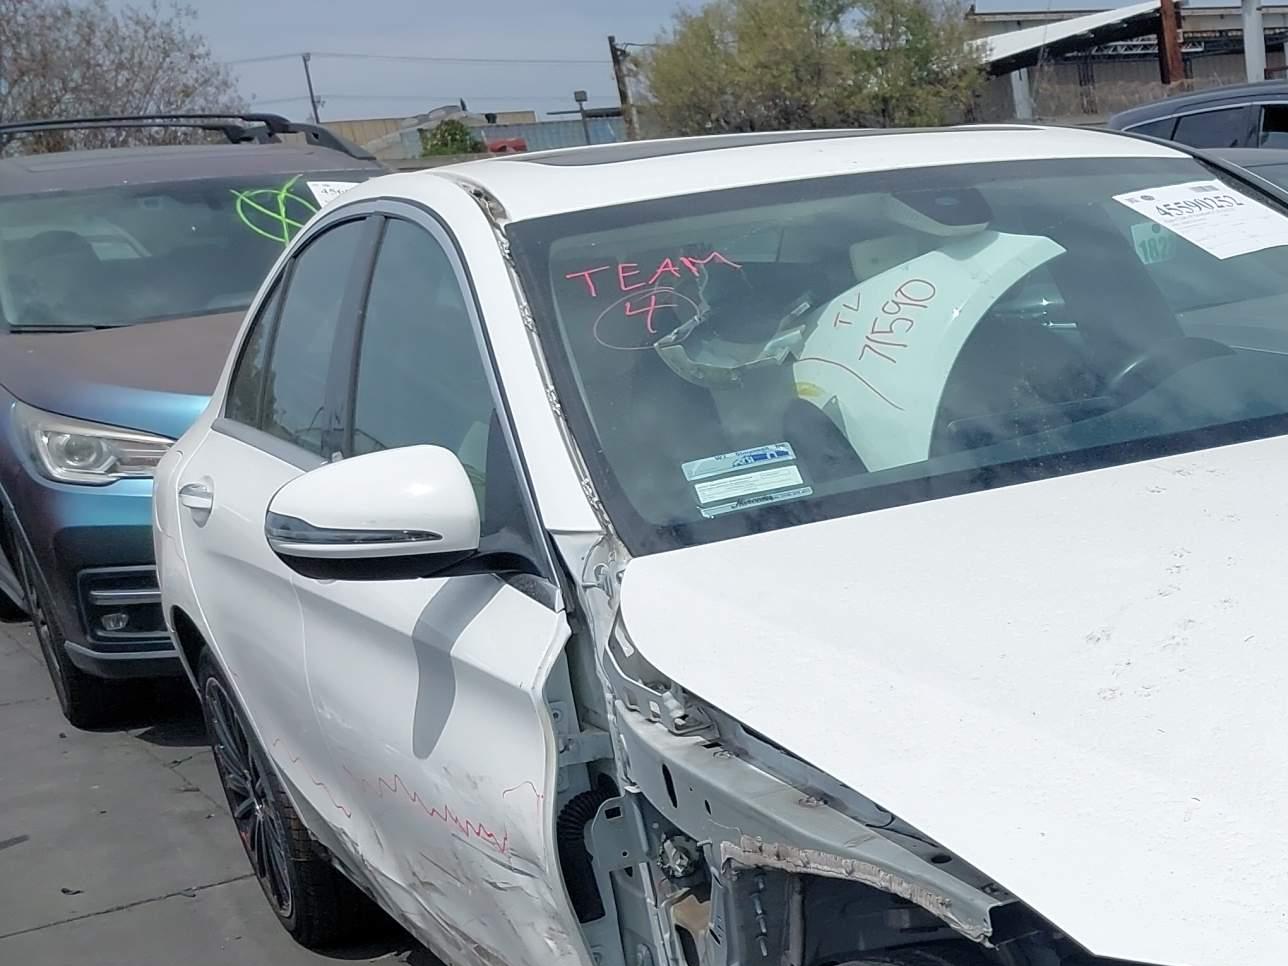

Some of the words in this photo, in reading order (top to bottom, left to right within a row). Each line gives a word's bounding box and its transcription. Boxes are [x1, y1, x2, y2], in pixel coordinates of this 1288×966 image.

[1155, 195, 1245, 218] 45590252
[565, 251, 743, 297] TEAM
[625, 295, 679, 334] 4
[858, 278, 936, 364] 71590
